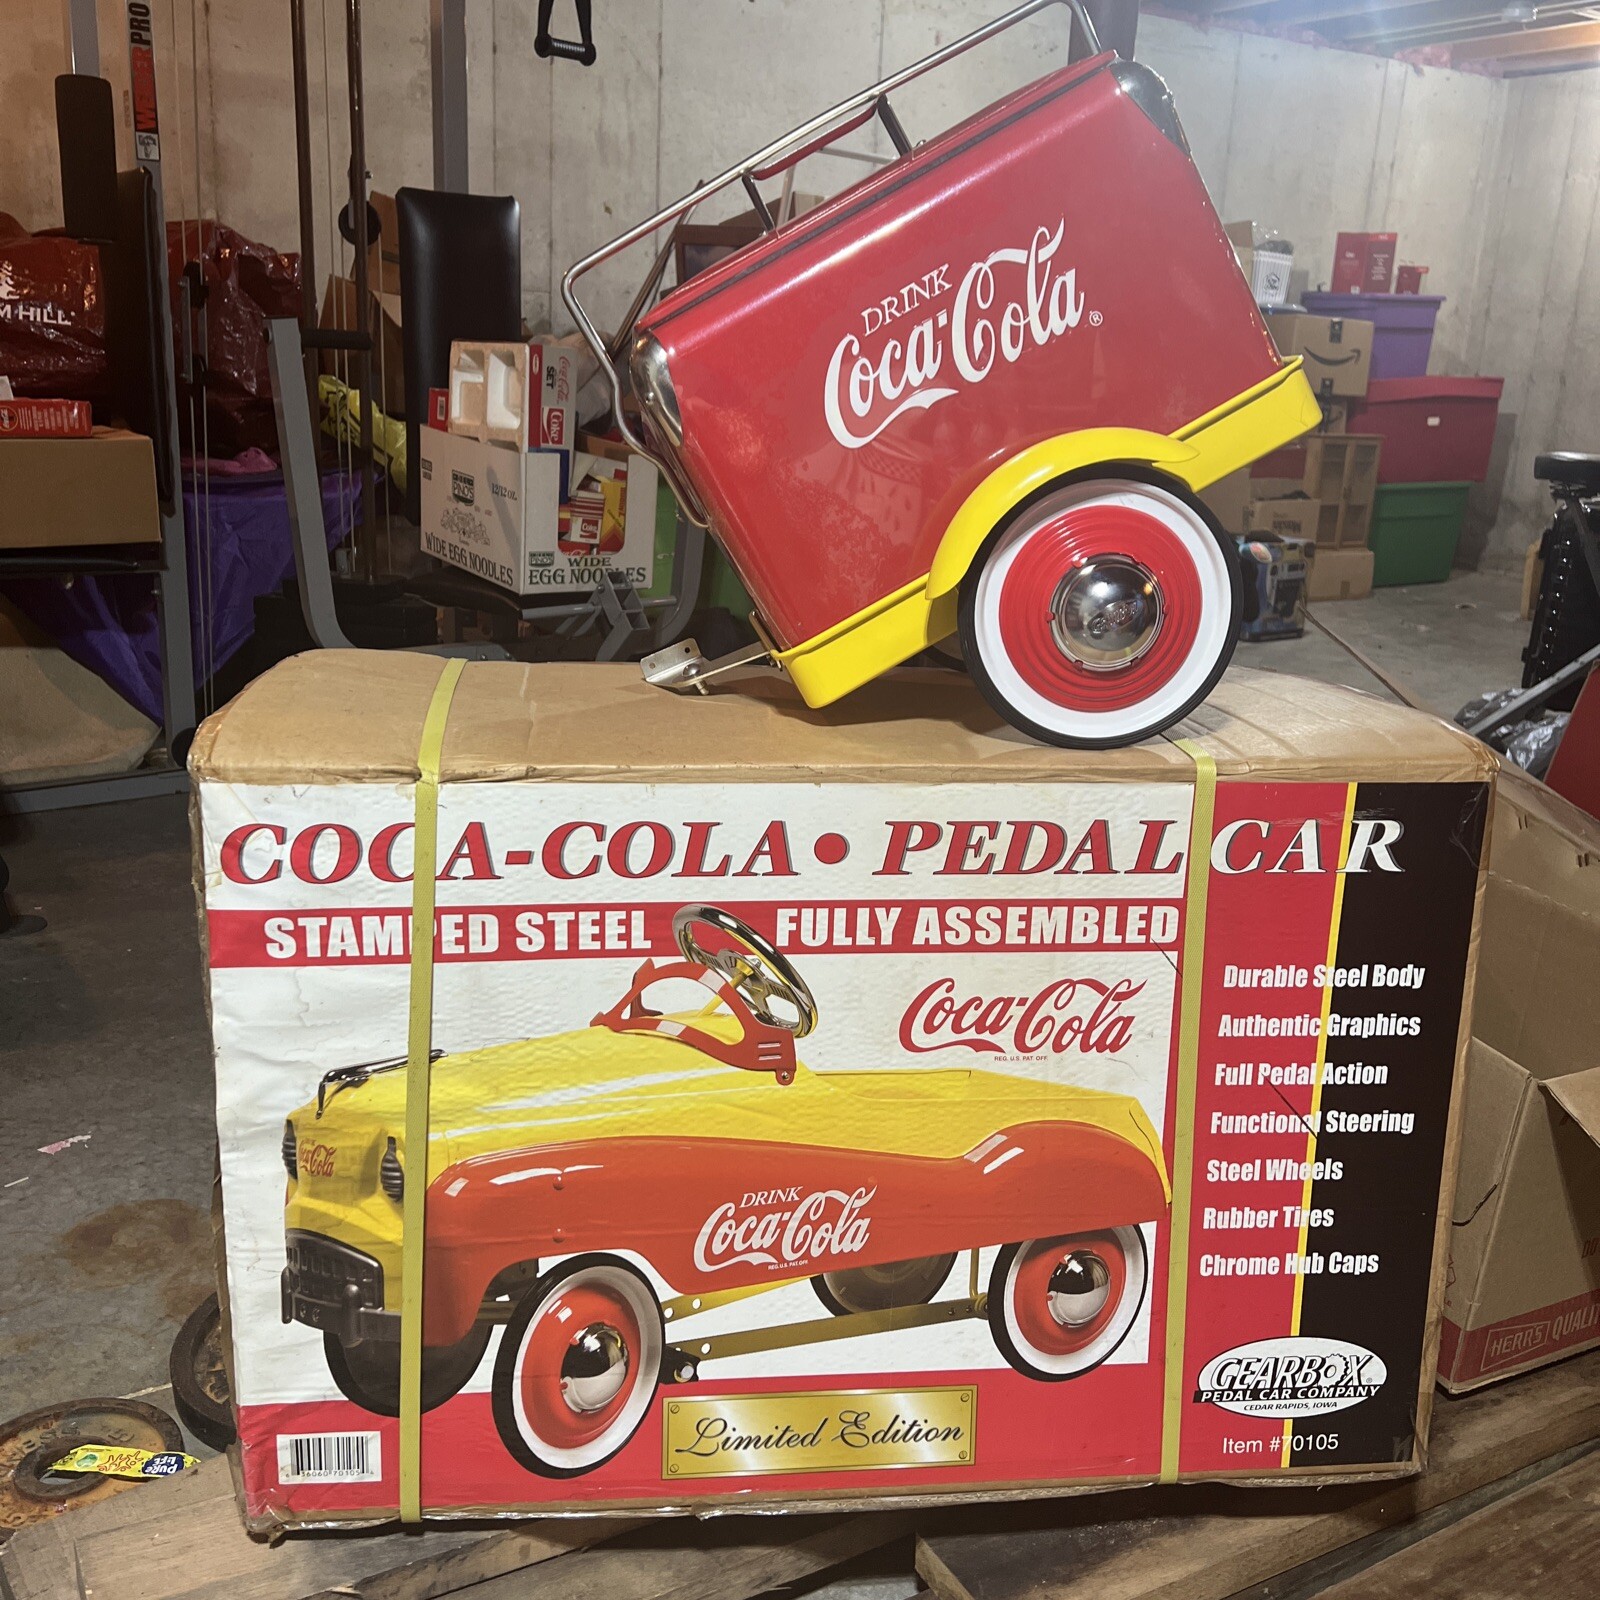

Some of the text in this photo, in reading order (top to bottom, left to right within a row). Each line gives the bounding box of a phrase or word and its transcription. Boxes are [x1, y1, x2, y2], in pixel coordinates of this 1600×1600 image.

[129, 2, 151, 46] PRO
[861, 263, 952, 337] DRINK
[18, 304, 72, 326] HILL
[824, 212, 1085, 449] Coca-Cola
[546, 365, 555, 389] SET
[550, 411, 562, 441] Coke
[581, 522, 598, 532] Coke
[425, 532, 514, 587] WIDE EGG NOODLES
[567, 556, 612, 567] WIDE
[528, 567, 647, 585] EGG NOOES
[872, 819, 1184, 876] PEDAL
[1210, 818, 1406, 875] CAR
[515, 910, 652, 953] STEEL
[776, 906, 903, 947] FULLY
[911, 905, 1180, 946] ASSEMBLED
[1223, 964, 1425, 990] Durable Steel Body
[899, 977, 1148, 1054] Coca-Cola
[1217, 1013, 1421, 1039] Authentic Graphics
[1214, 1062, 1389, 1086] Full Pedal Action
[1210, 1109, 1415, 1135] Functional Steering
[1206, 1158, 1344, 1182] Steel Wheels
[739, 1185, 804, 1209] DRINK
[693, 1184, 878, 1273] Coca-Cola
[1202, 1206, 1335, 1230] Rubber Tires
[1199, 1251, 1379, 1277] Chrome Hub Caps
[1210, 1353, 1374, 1390] GEARBOX
[1201, 1385, 1381, 1402] PEDAL CAR COMPANY
[1243, 1401, 1338, 1411] CEDAR RAPIDS, IOWA
[675, 1409, 965, 1458] Limited Edition
[1222, 1433, 1339, 1454] Item #70105
